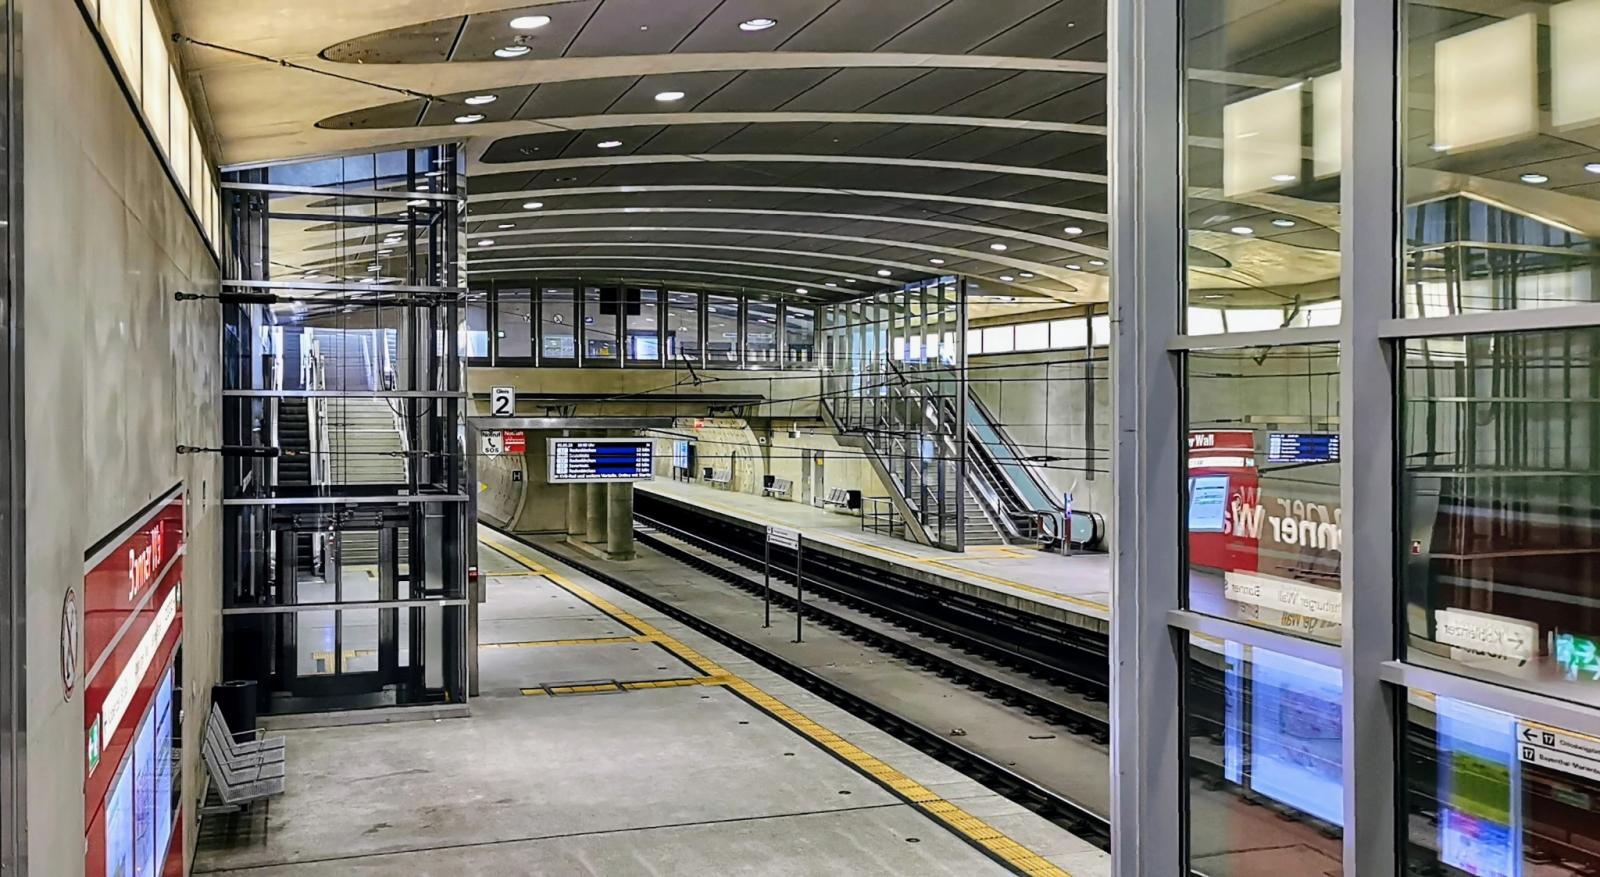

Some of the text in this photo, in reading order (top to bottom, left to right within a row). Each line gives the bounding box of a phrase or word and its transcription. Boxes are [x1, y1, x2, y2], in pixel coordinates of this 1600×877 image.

[495, 396, 510, 414] 2
[1195, 433, 1214, 447] Wall
[129, 545, 152, 602] Bonner
[1543, 733, 1555, 746] 17
[1523, 748, 1535, 761] 17
